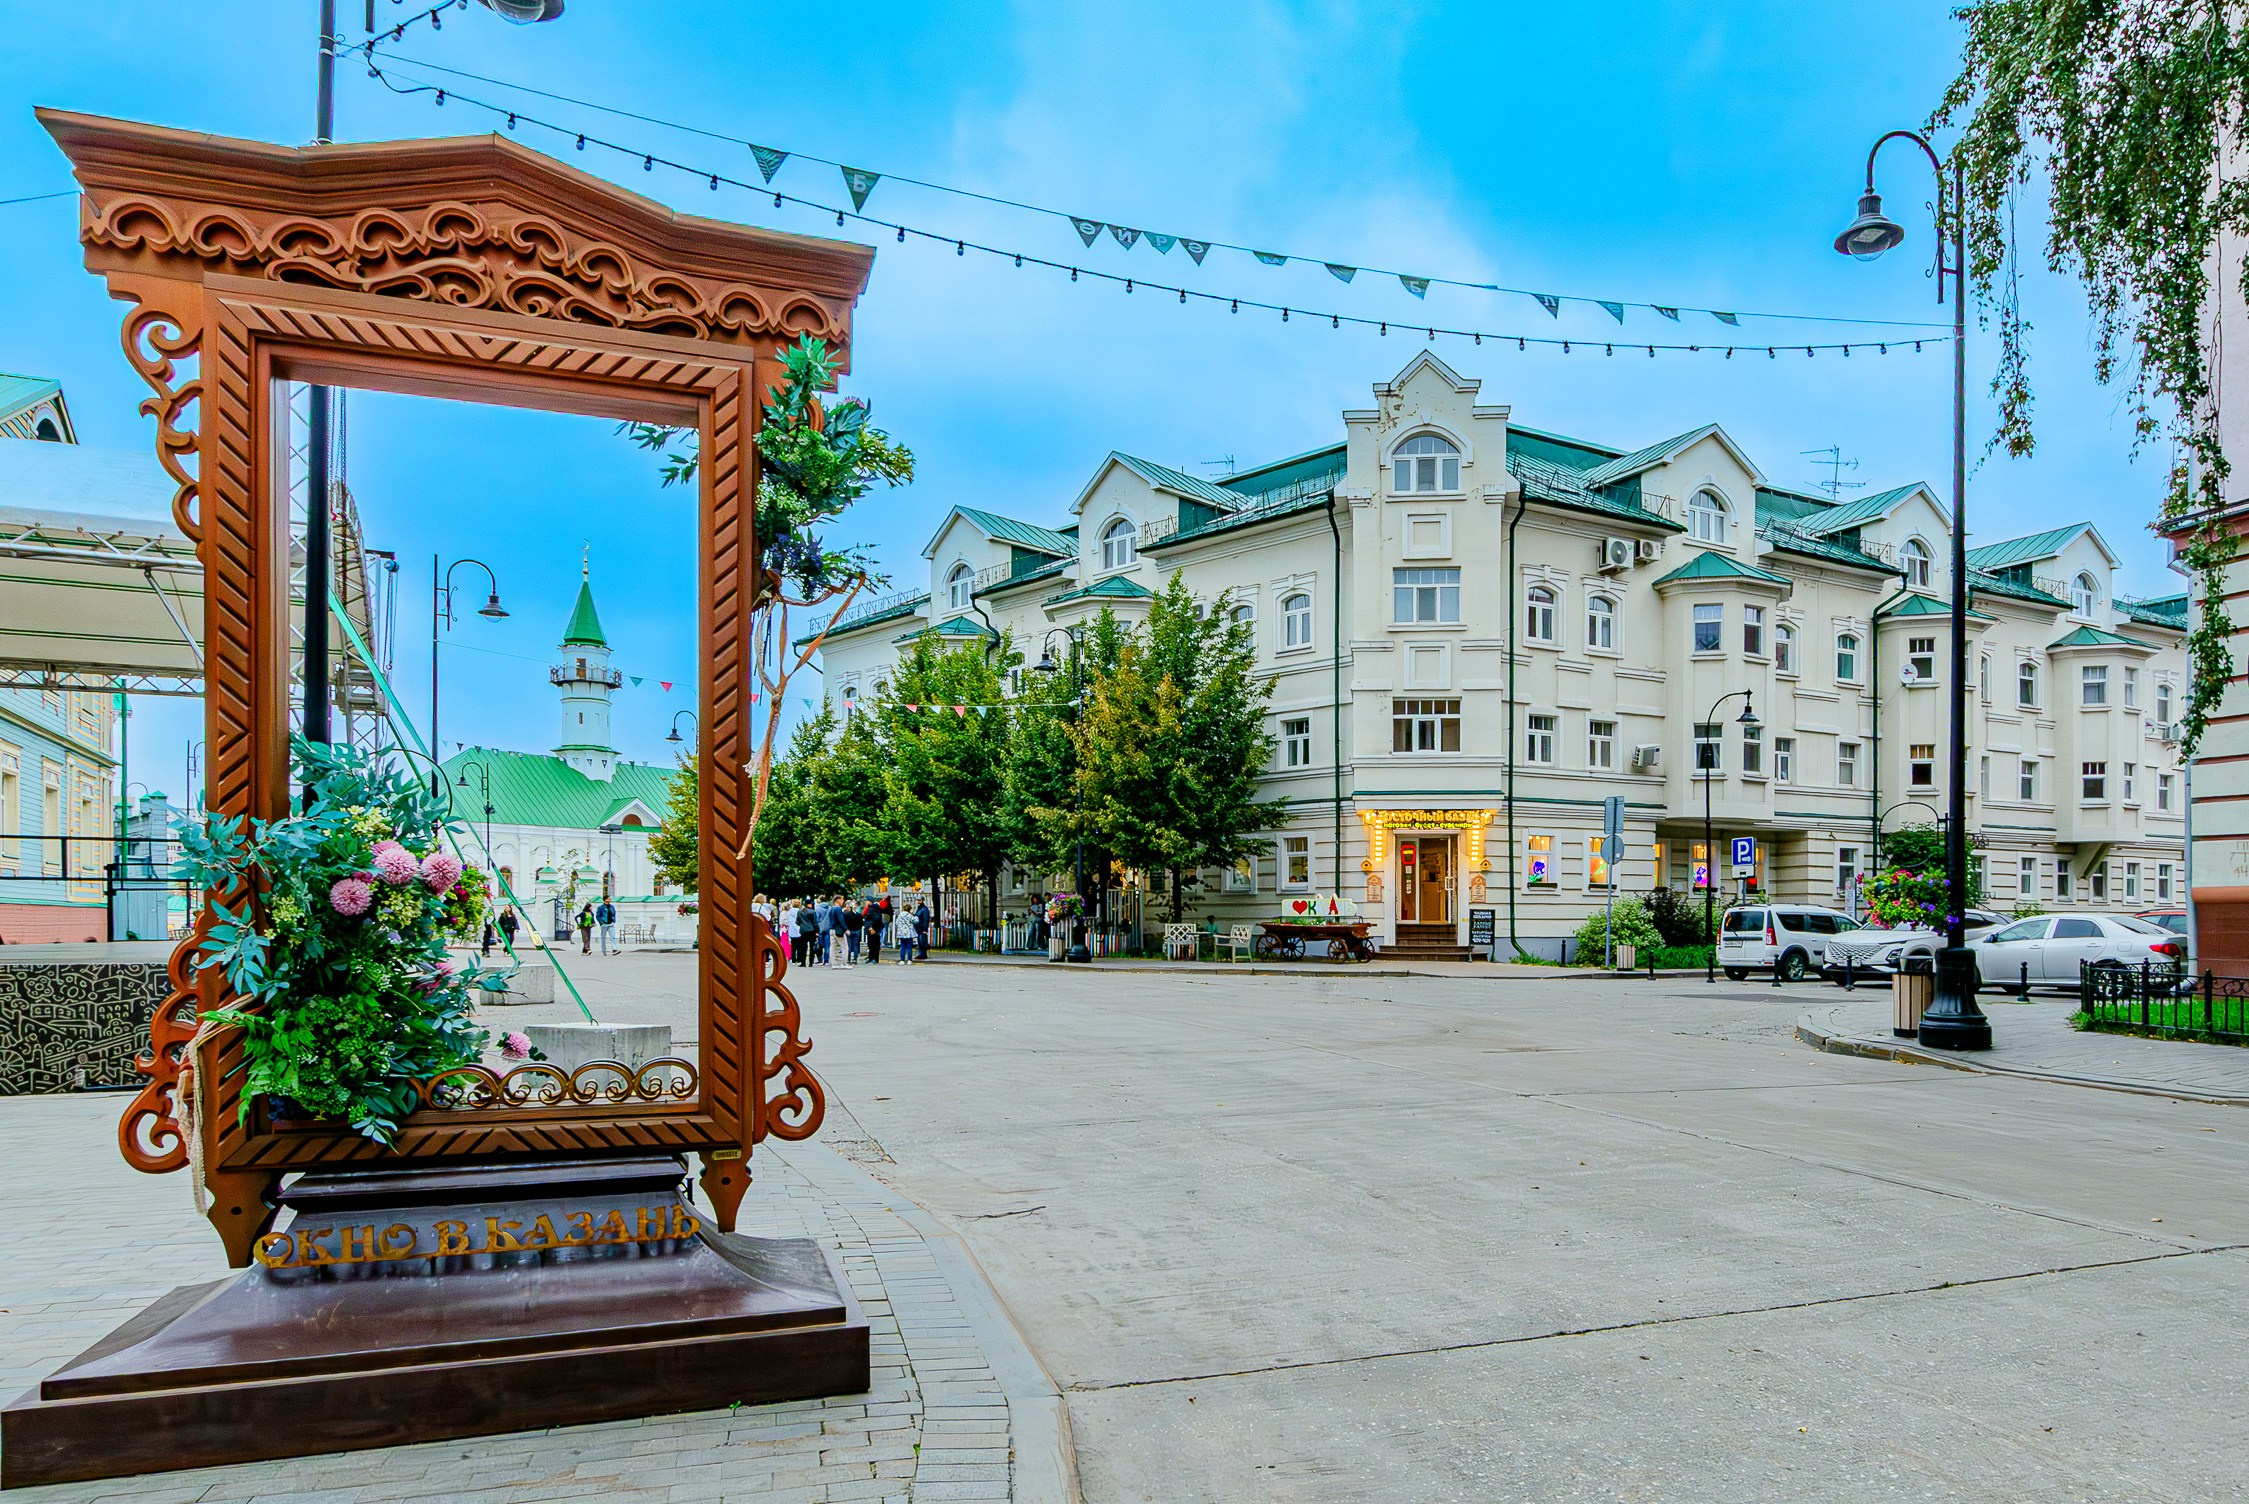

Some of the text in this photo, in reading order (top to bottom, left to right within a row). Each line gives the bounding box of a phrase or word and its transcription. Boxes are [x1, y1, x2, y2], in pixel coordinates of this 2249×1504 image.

[254, 1204, 700, 1268] ОКНО В КАЗАНЬ
